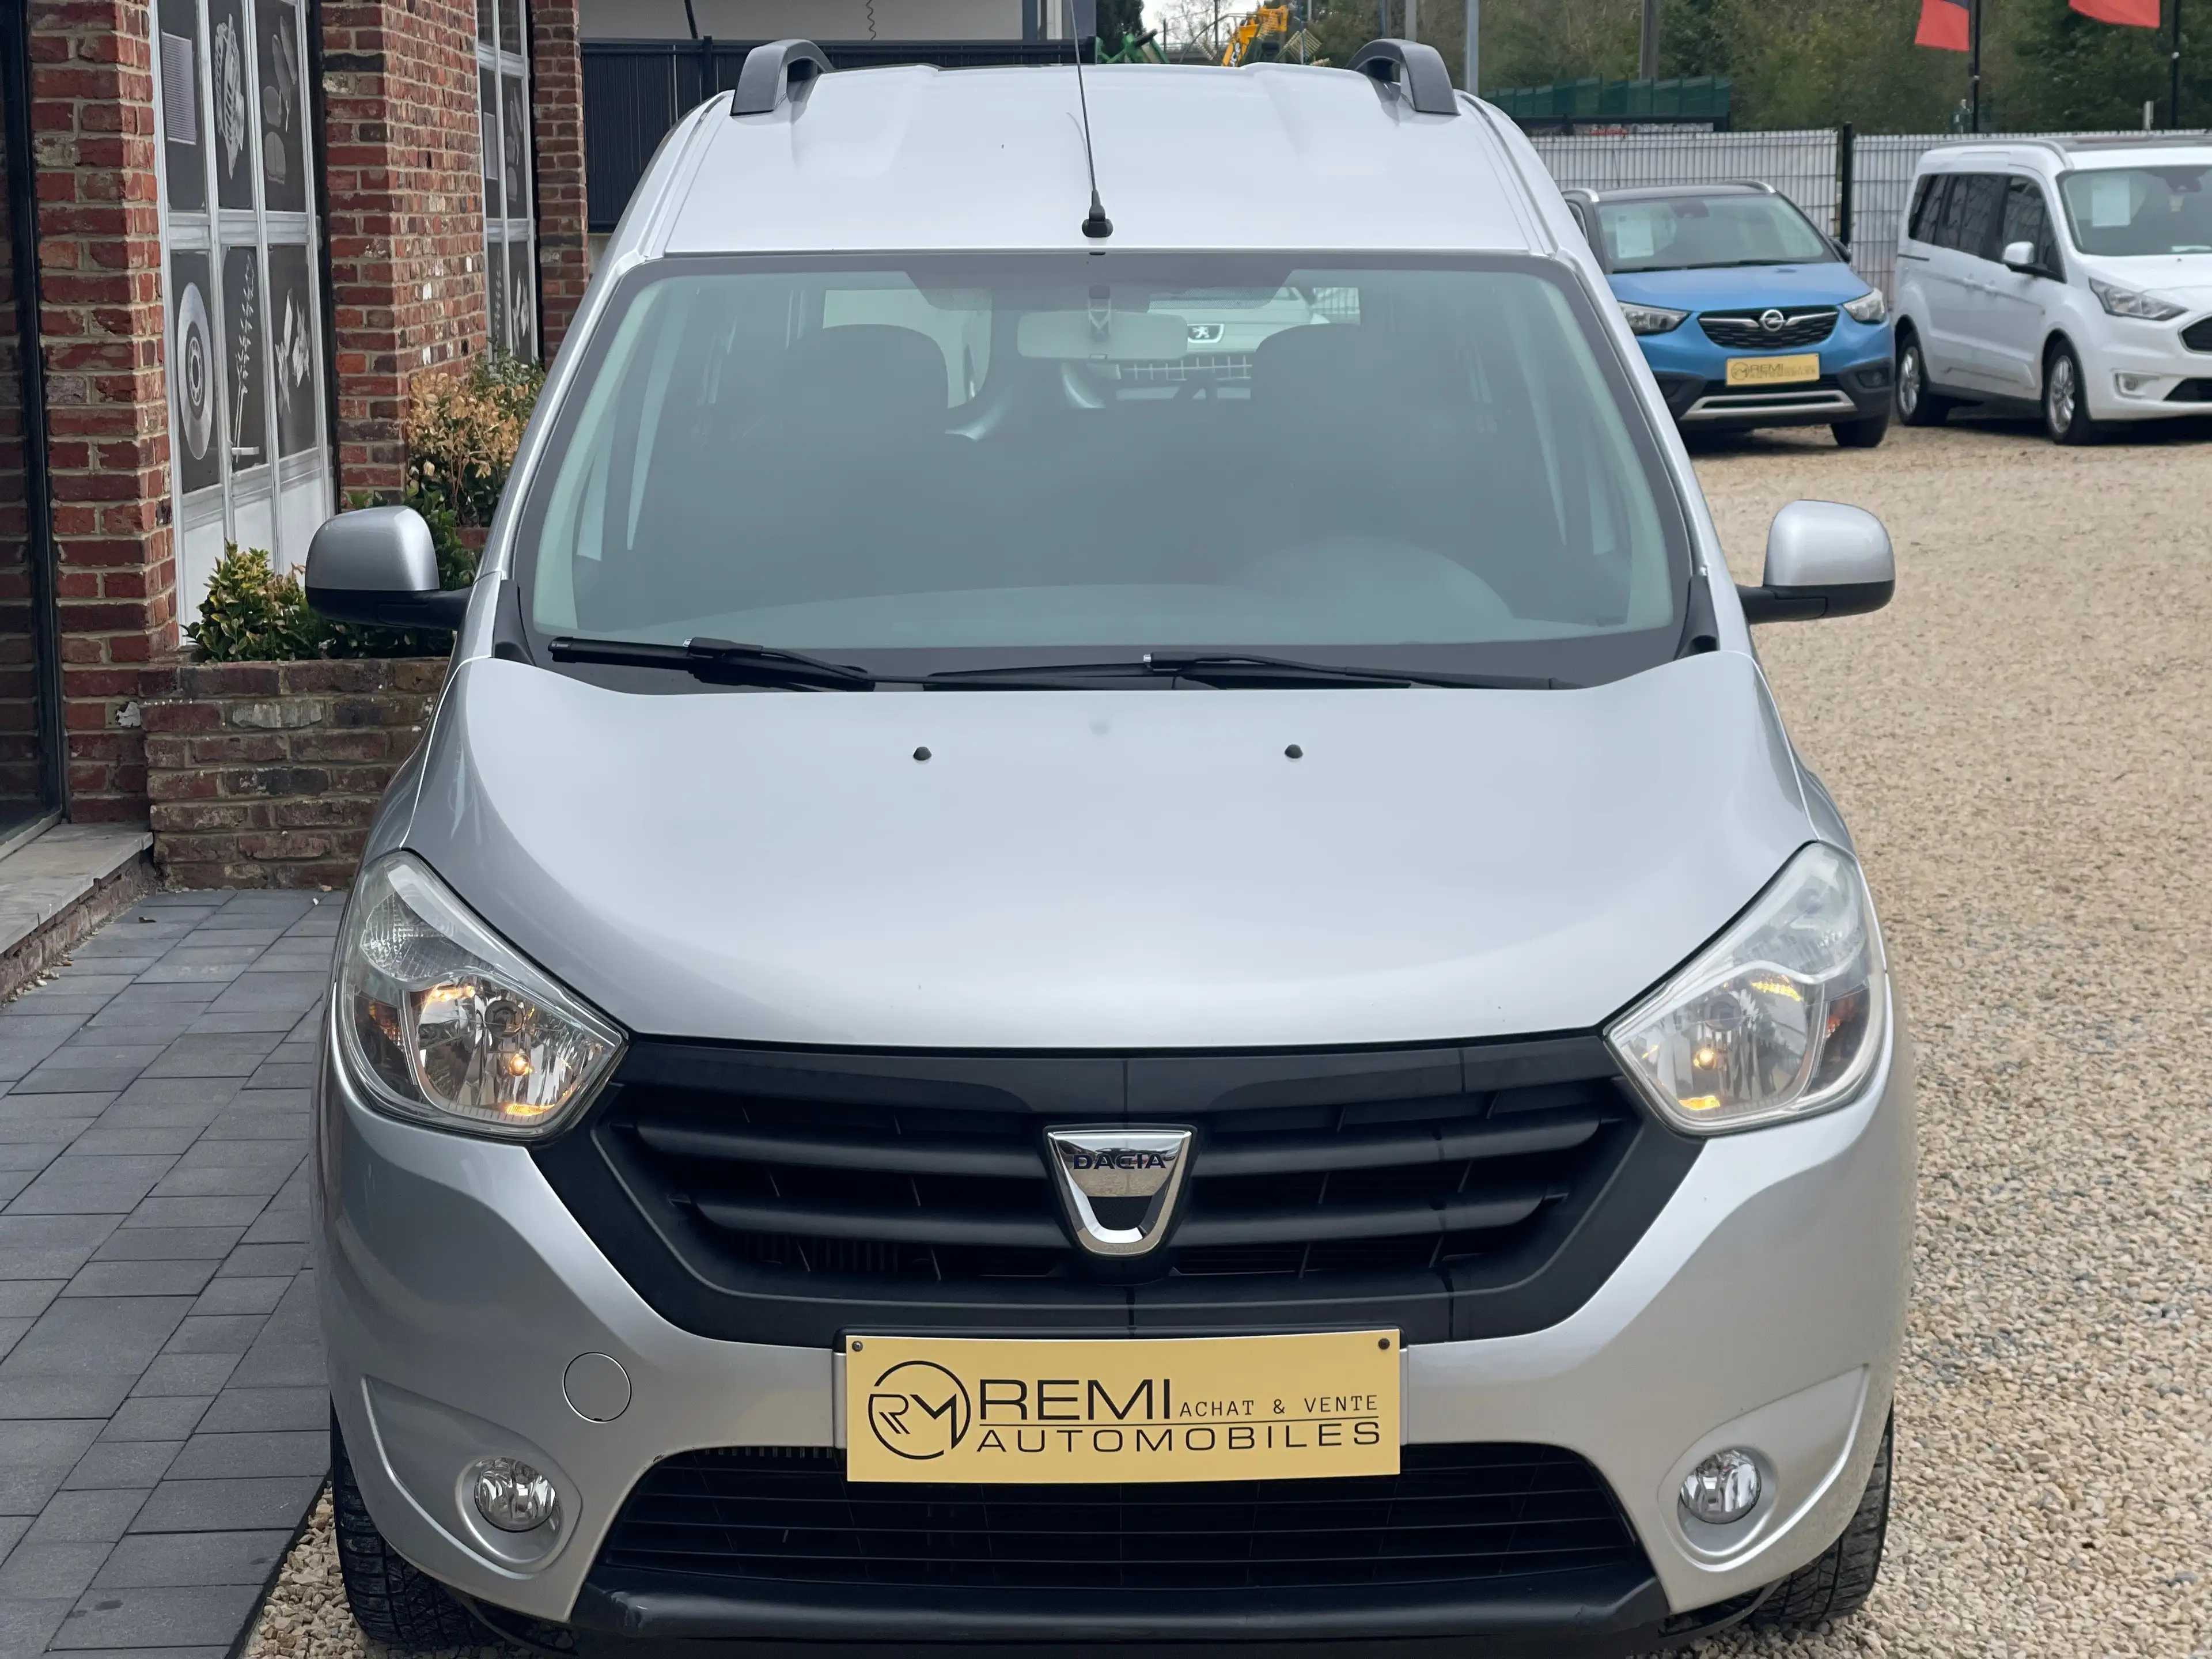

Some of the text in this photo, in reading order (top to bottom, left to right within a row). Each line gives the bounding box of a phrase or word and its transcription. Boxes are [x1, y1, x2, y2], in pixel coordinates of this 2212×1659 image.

[1750, 363, 1783, 373] REMI
[1073, 1153, 1166, 1169] DACIA
[980, 1378, 1377, 1420] REMI ACHAT & VENTE
[976, 1421, 1380, 1453] AUTOMOBILES
